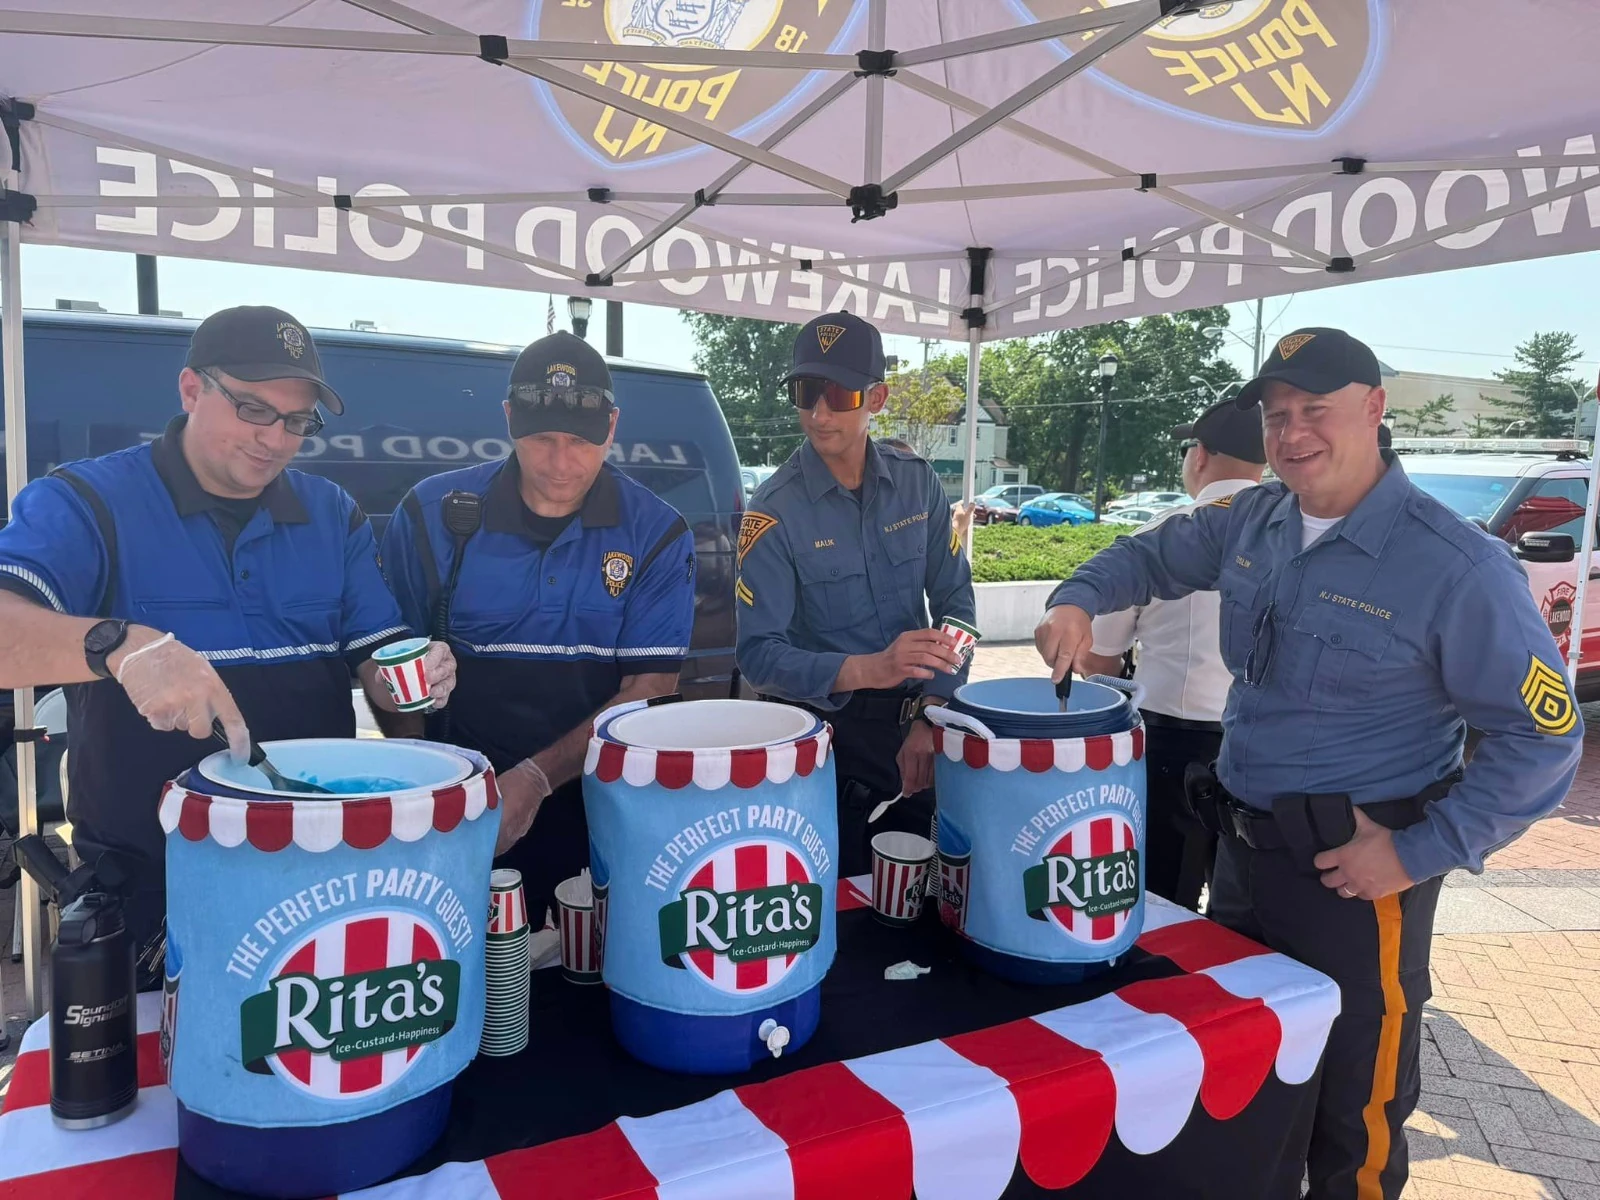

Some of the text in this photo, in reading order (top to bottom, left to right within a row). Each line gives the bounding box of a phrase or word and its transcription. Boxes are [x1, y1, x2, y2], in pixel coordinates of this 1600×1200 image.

[547, 363, 576, 376] LAKEWOOD
[893, 519, 912, 531] STATE
[815, 539, 835, 549] MALIK
[603, 551, 634, 567] LAKEWOOD
[606, 577, 626, 588] POLICE
[1557, 587, 1570, 596] FIRE
[1319, 591, 1392, 620] NJ STATE POLICE
[1011, 825, 1040, 857] THE
[1035, 786, 1096, 834] PERFECT
[1100, 784, 1136, 810] PARTY
[645, 804, 831, 892] THE PERFECT PARTY GUEST!
[1047, 851, 1136, 908] Rita's
[226, 868, 475, 980] THE PERFECT PARTY GUEST!
[684, 884, 813, 951] Rita's
[274, 962, 445, 1050] Rita's
